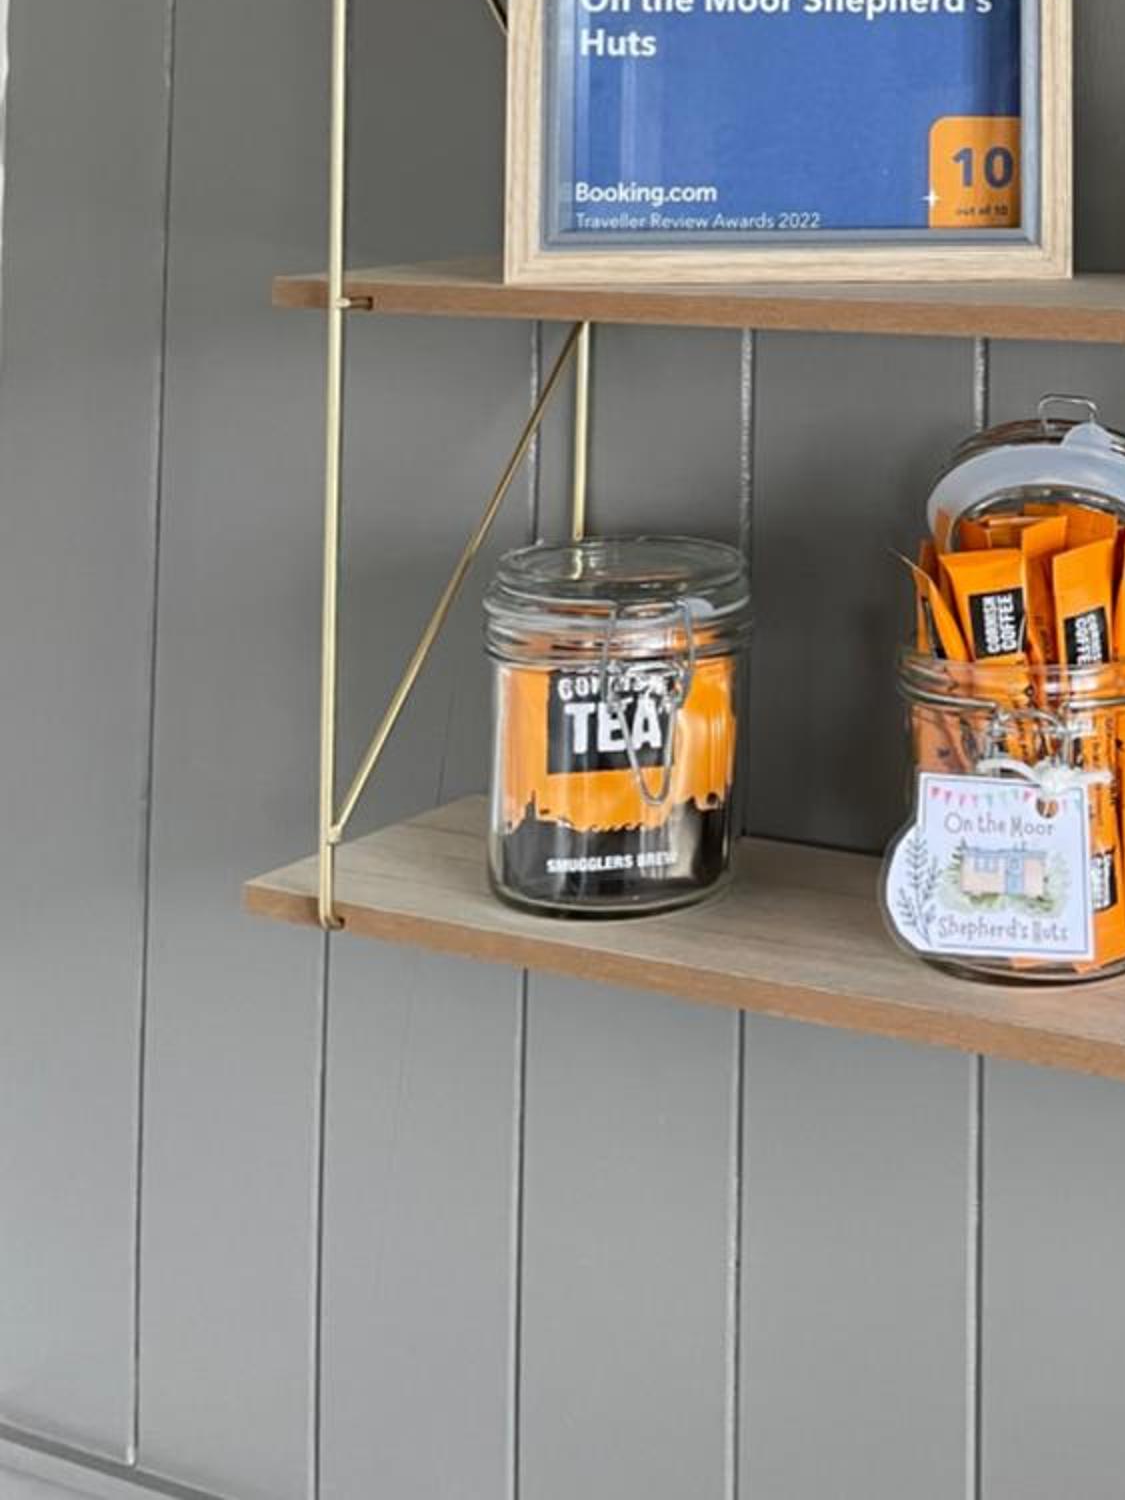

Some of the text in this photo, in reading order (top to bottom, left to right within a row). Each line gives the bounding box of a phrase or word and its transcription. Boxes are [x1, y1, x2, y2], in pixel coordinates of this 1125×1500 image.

[580, 28, 657, 57] Huts
[952, 147, 1014, 190] 10
[575, 181, 718, 207] Booking.com
[575, 211, 821, 229] Traveller Review Awards 2022
[563, 693, 662, 755] TEA
[944, 811, 1054, 837] On the Moor
[546, 854, 634, 874] SMUGGLERS
